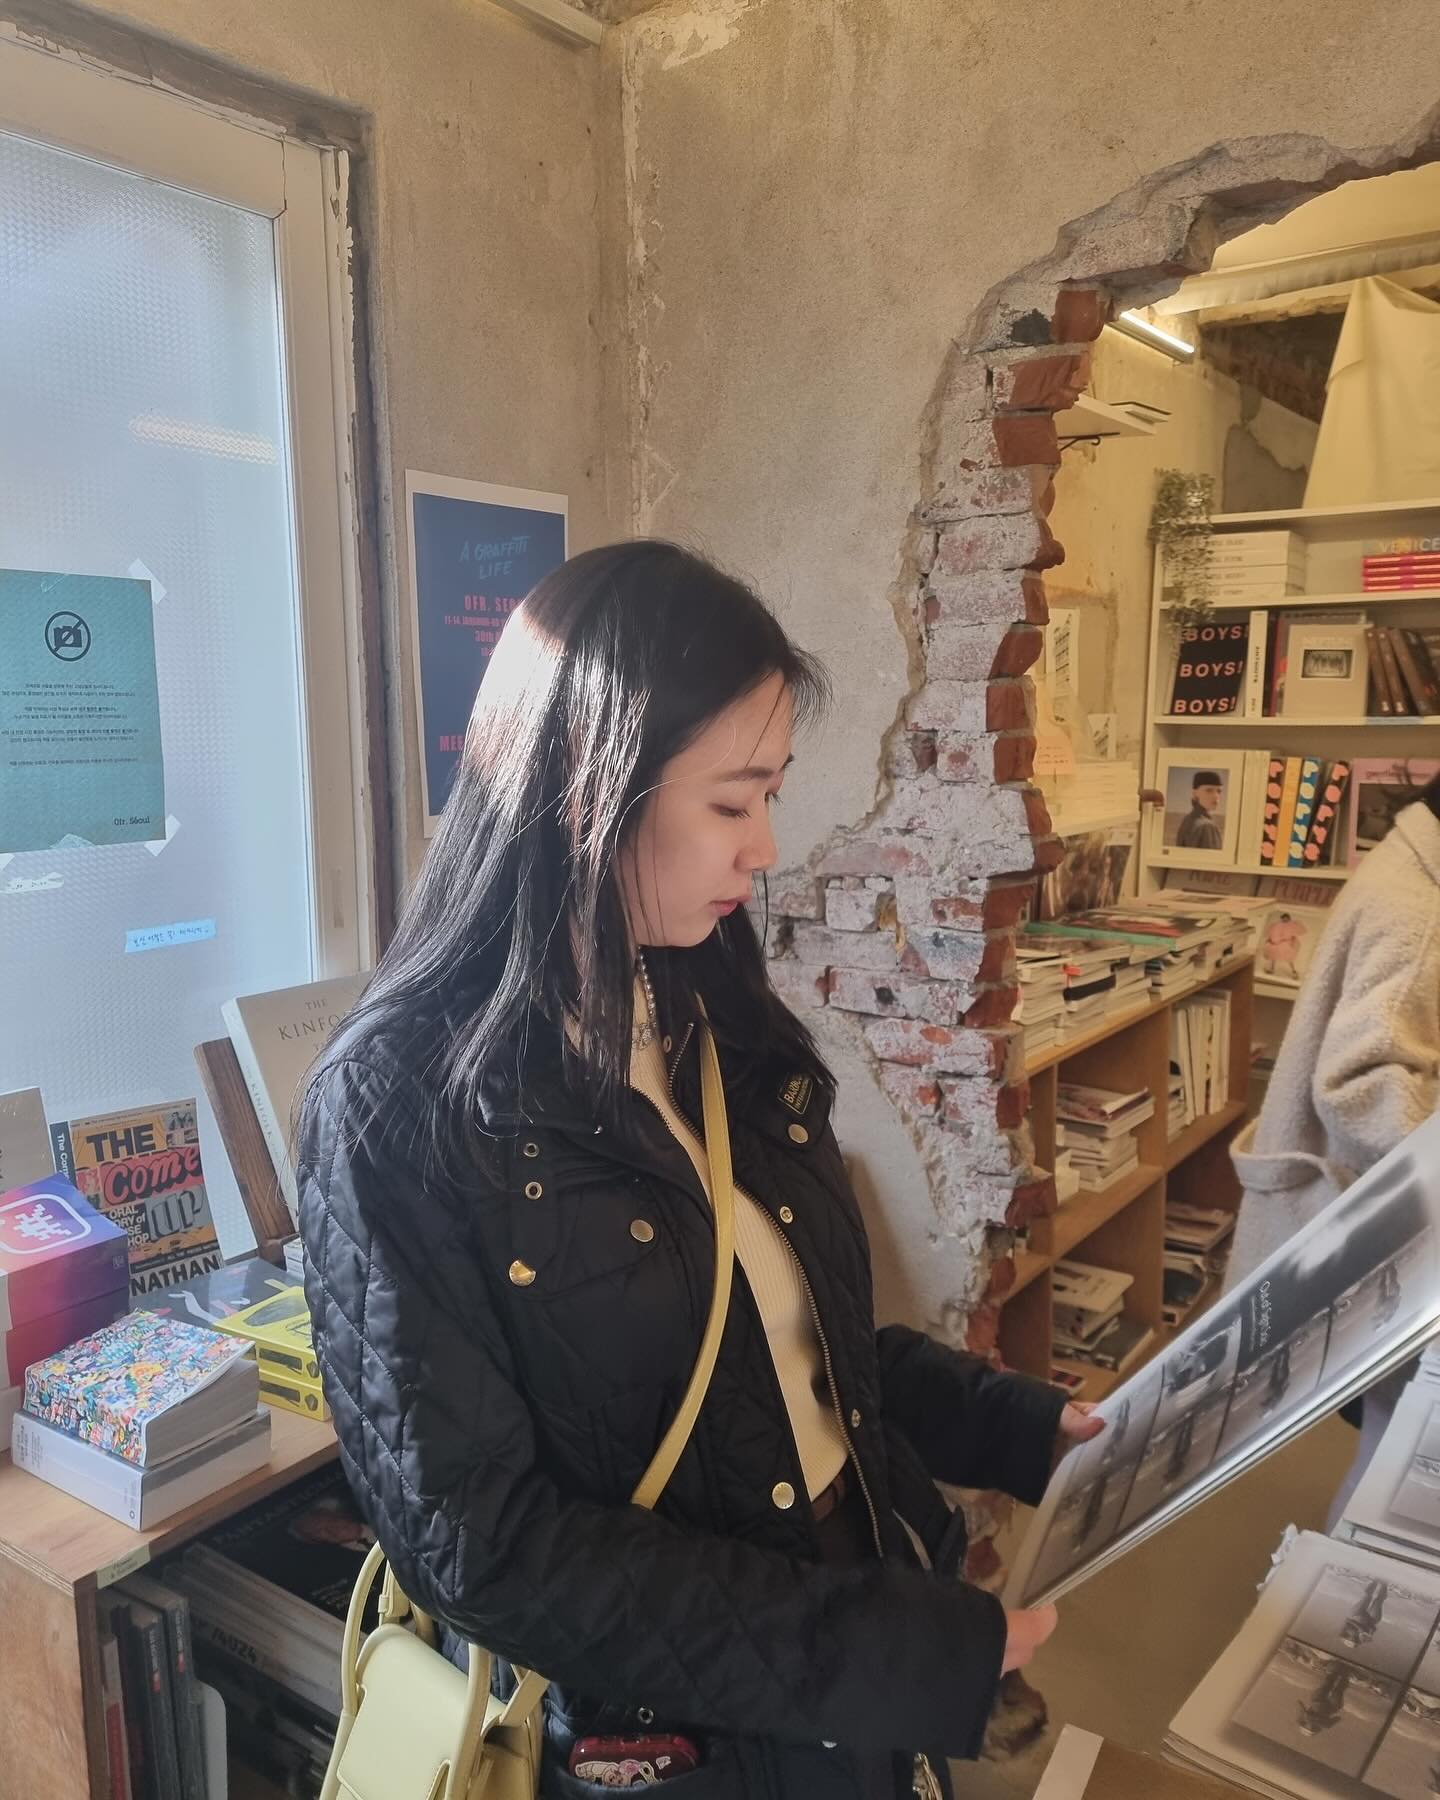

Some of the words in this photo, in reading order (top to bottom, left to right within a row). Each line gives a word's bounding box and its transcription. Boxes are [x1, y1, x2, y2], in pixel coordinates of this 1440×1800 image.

[480, 561, 512, 580] LIFE
[1180, 661, 1243, 677] BOYS!
[1174, 696, 1236, 713] BOYS!
[440, 735, 464, 752] MEE
[278, 1014, 341, 1040] KINFO
[56, 1132, 65, 1151] The
[86, 1123, 156, 1162] THE
[109, 1205, 138, 1219] ORAL
[136, 1212, 145, 1223] of
